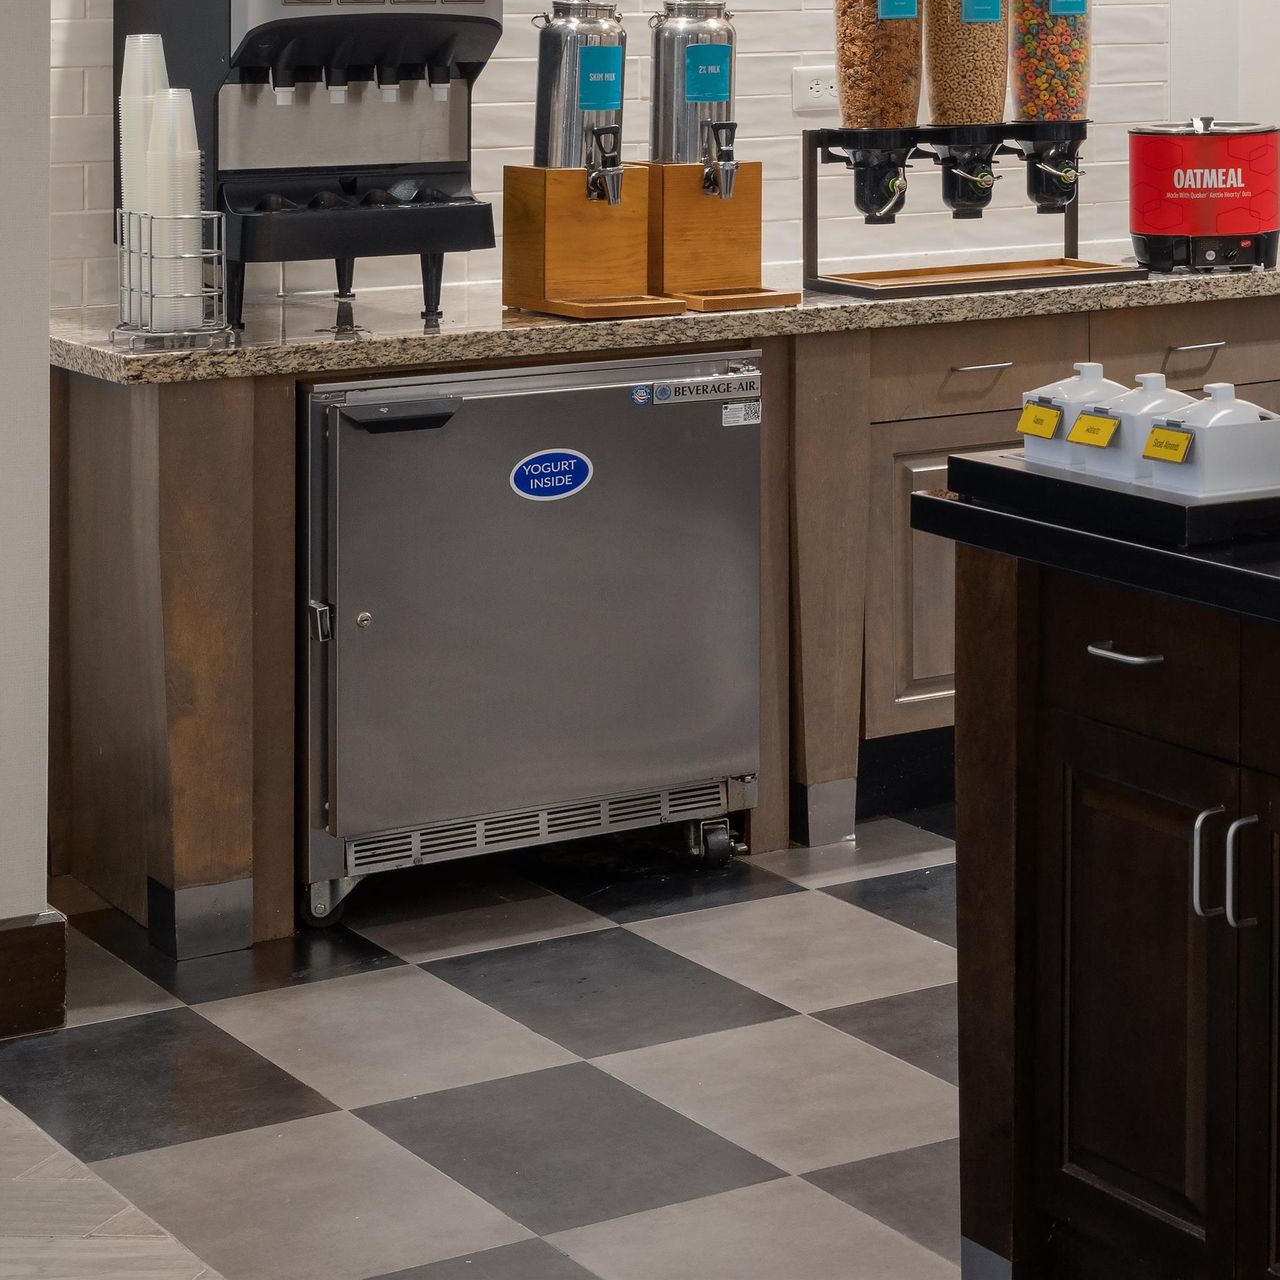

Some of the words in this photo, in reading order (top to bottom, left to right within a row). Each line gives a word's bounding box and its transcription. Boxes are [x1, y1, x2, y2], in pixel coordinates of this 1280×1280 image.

[589, 72, 604, 82] SKIM
[604, 72, 616, 81] MILK
[698, 65, 707, 74] 2%
[708, 65, 721, 74] MILK
[1173, 167, 1245, 189] OATMEAL
[522, 459, 577, 476] YOGURT
[530, 474, 573, 489] INSIDE
